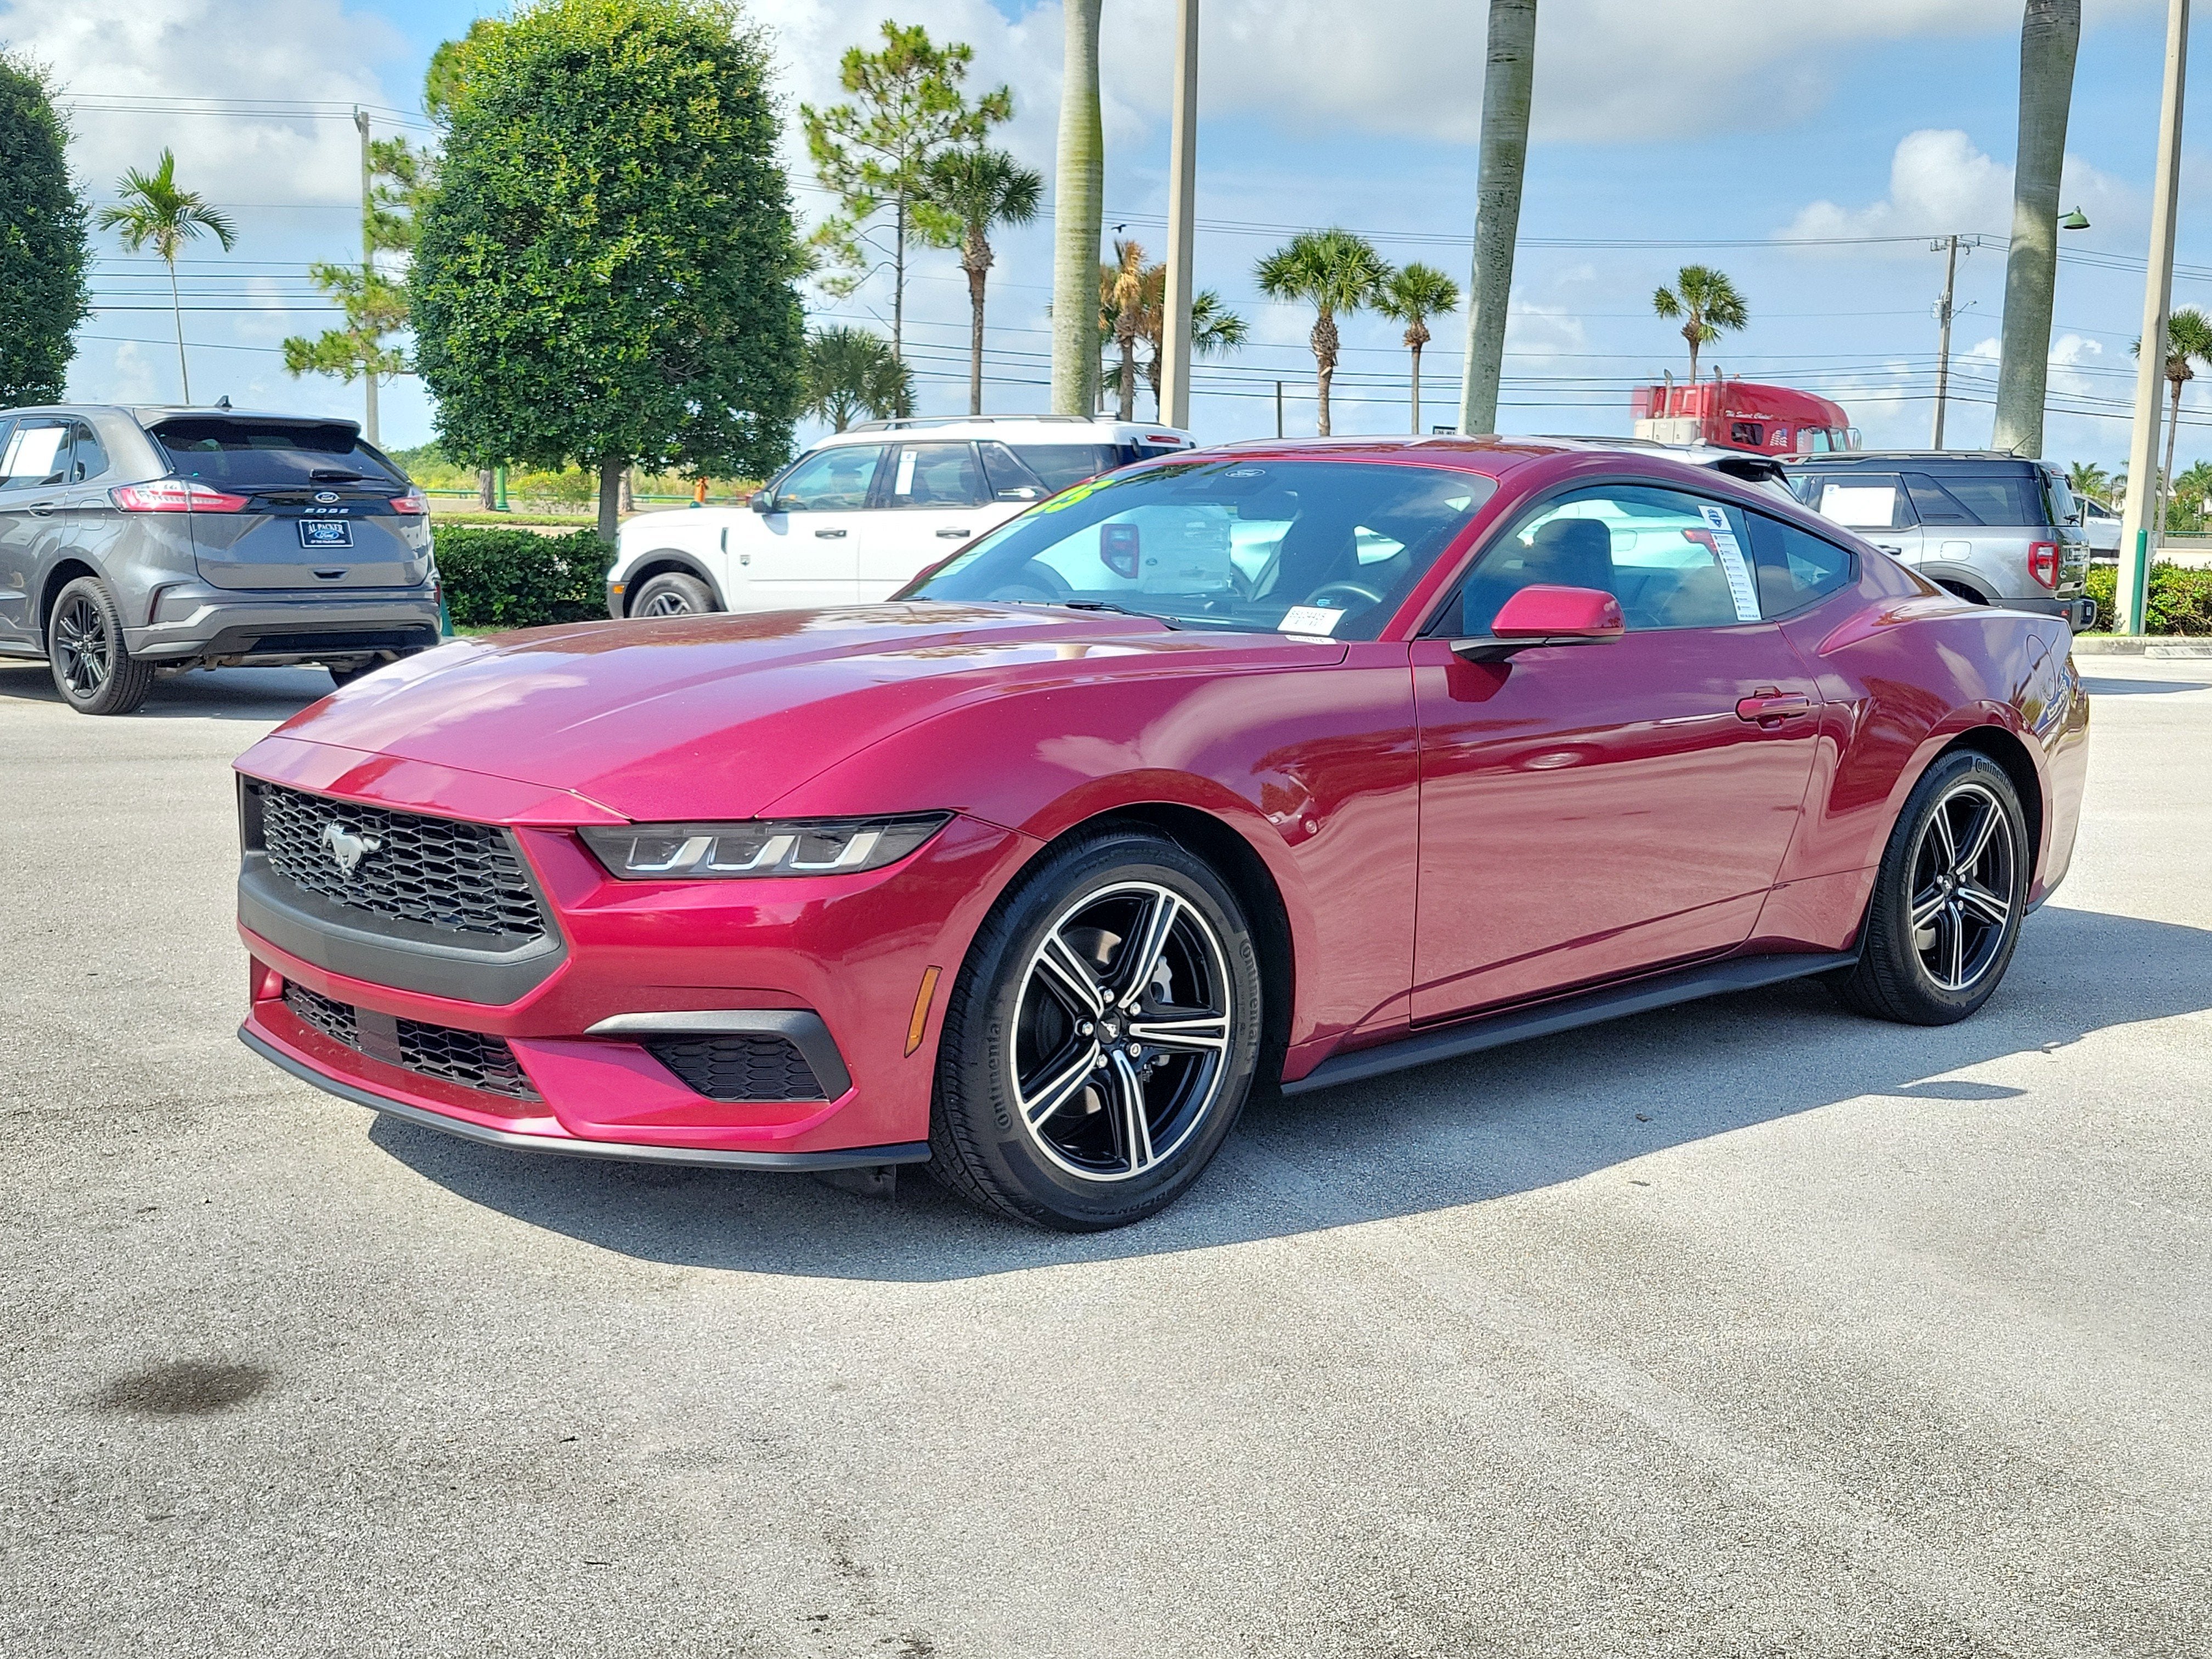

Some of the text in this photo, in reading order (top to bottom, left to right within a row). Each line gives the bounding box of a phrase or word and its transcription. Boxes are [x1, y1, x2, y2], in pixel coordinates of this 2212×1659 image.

[308, 523, 344, 534] AL PACKER
[1976, 758, 2011, 792] Continental
[1239, 937, 1259, 1047] Continental
